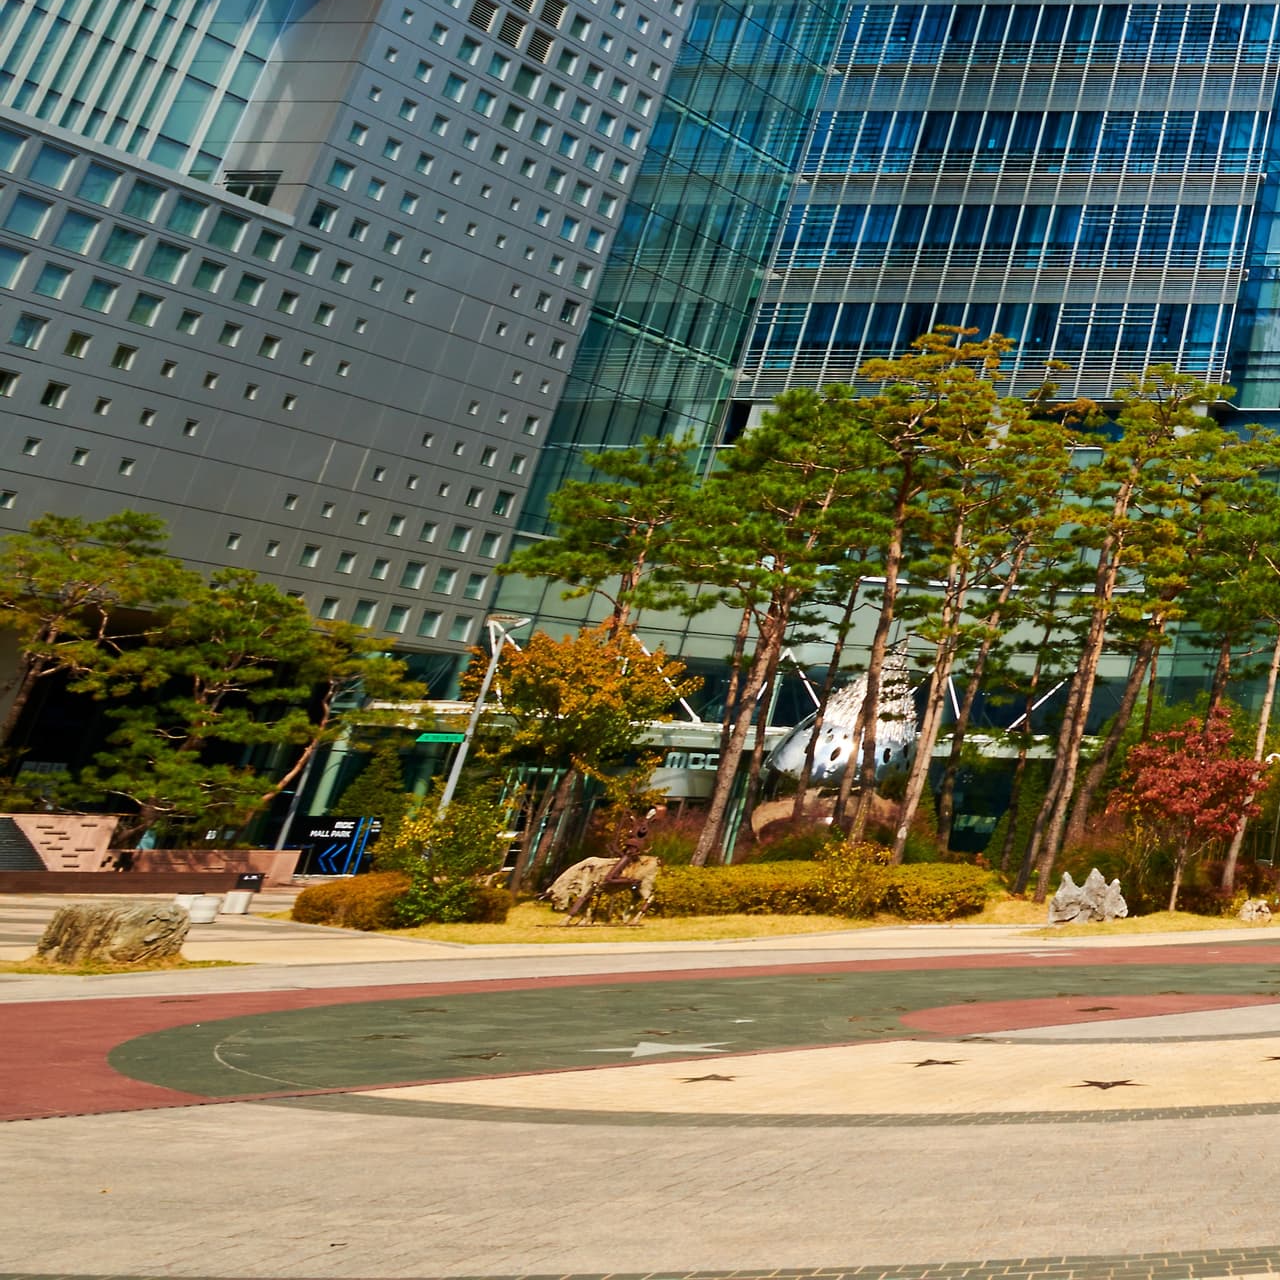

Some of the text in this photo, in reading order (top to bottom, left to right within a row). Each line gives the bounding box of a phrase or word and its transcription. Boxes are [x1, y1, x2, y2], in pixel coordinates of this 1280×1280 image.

[665, 752, 720, 770] MBC
[310, 830, 352, 838] MALL PARK
